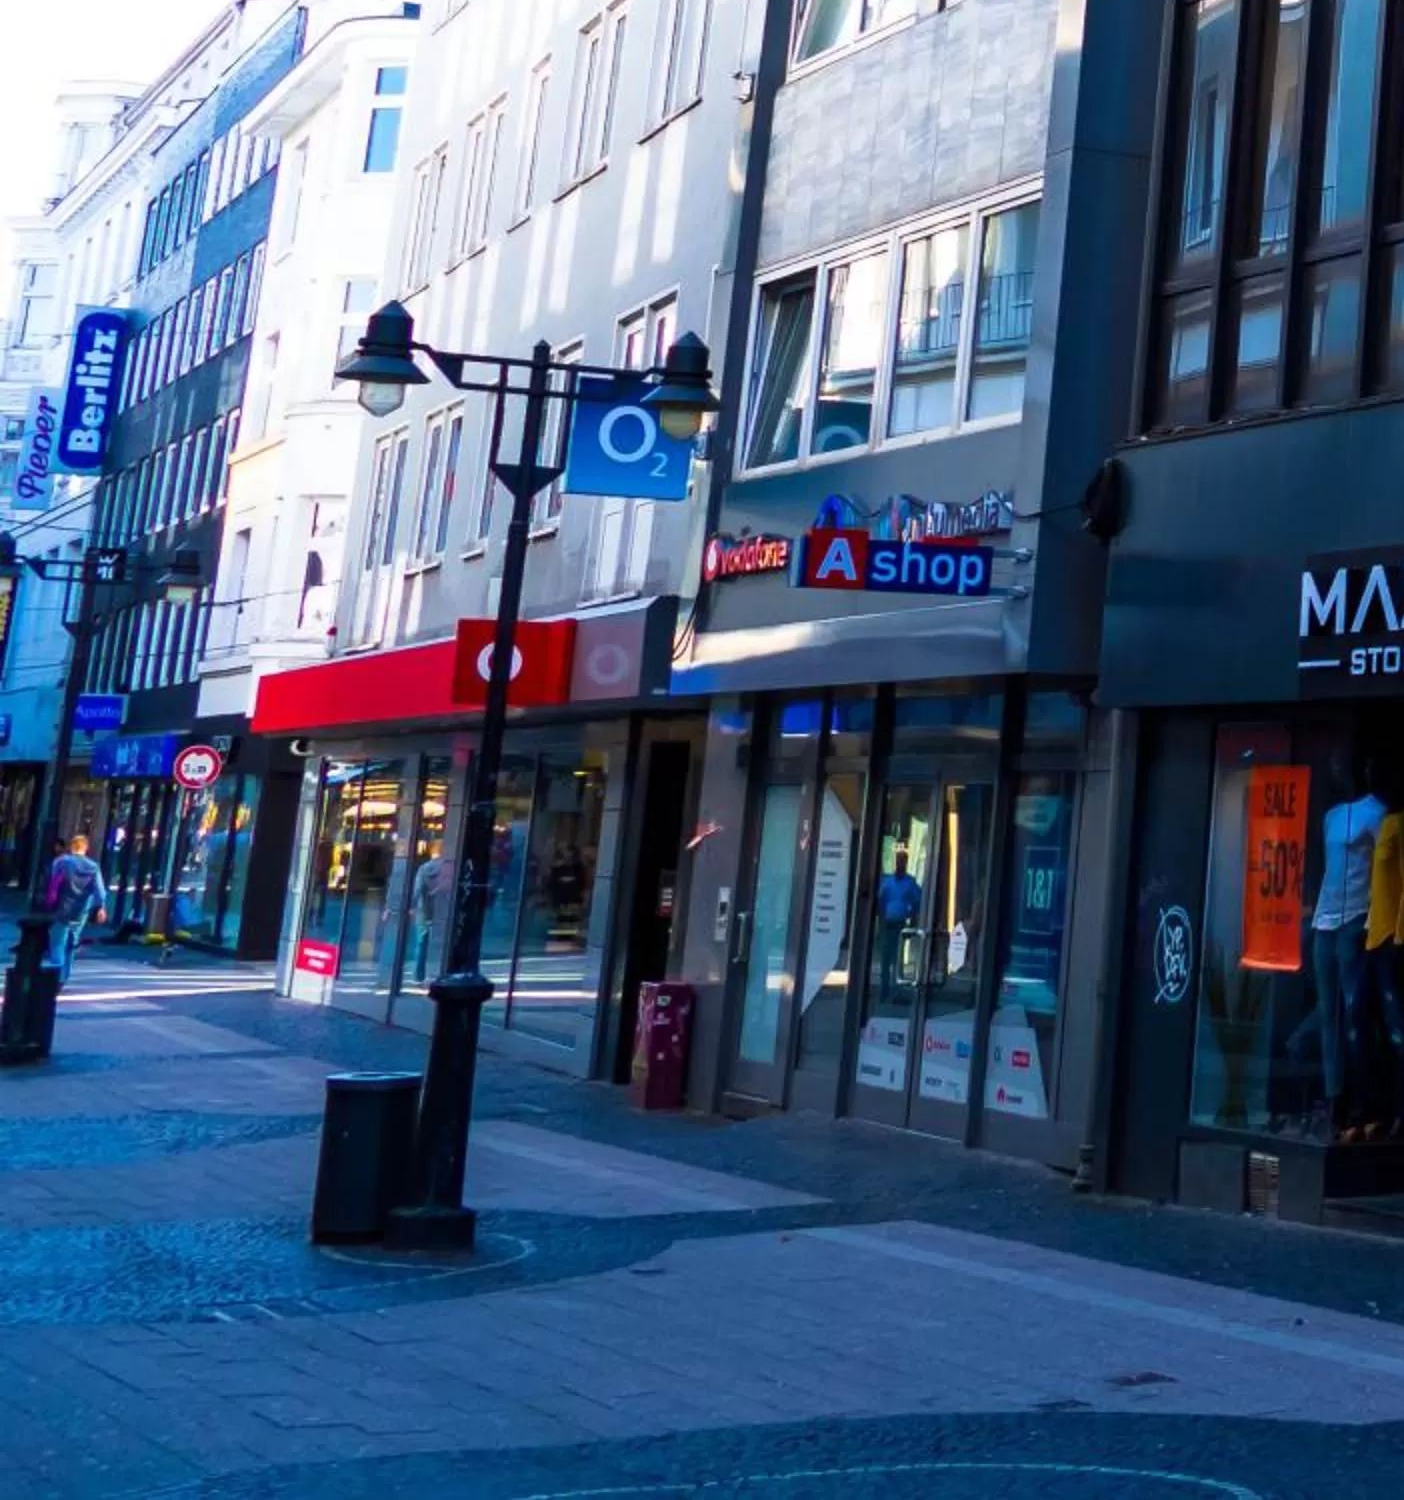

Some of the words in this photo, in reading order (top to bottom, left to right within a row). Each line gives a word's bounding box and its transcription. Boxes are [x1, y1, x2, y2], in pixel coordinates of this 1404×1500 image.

[66, 328, 119, 453] Berlitz
[720, 536, 788, 576] vodafone
[815, 537, 856, 582] A
[871, 541, 985, 596] shop
[1263, 782, 1297, 818] SALE
[1026, 867, 1055, 911] 1&1
